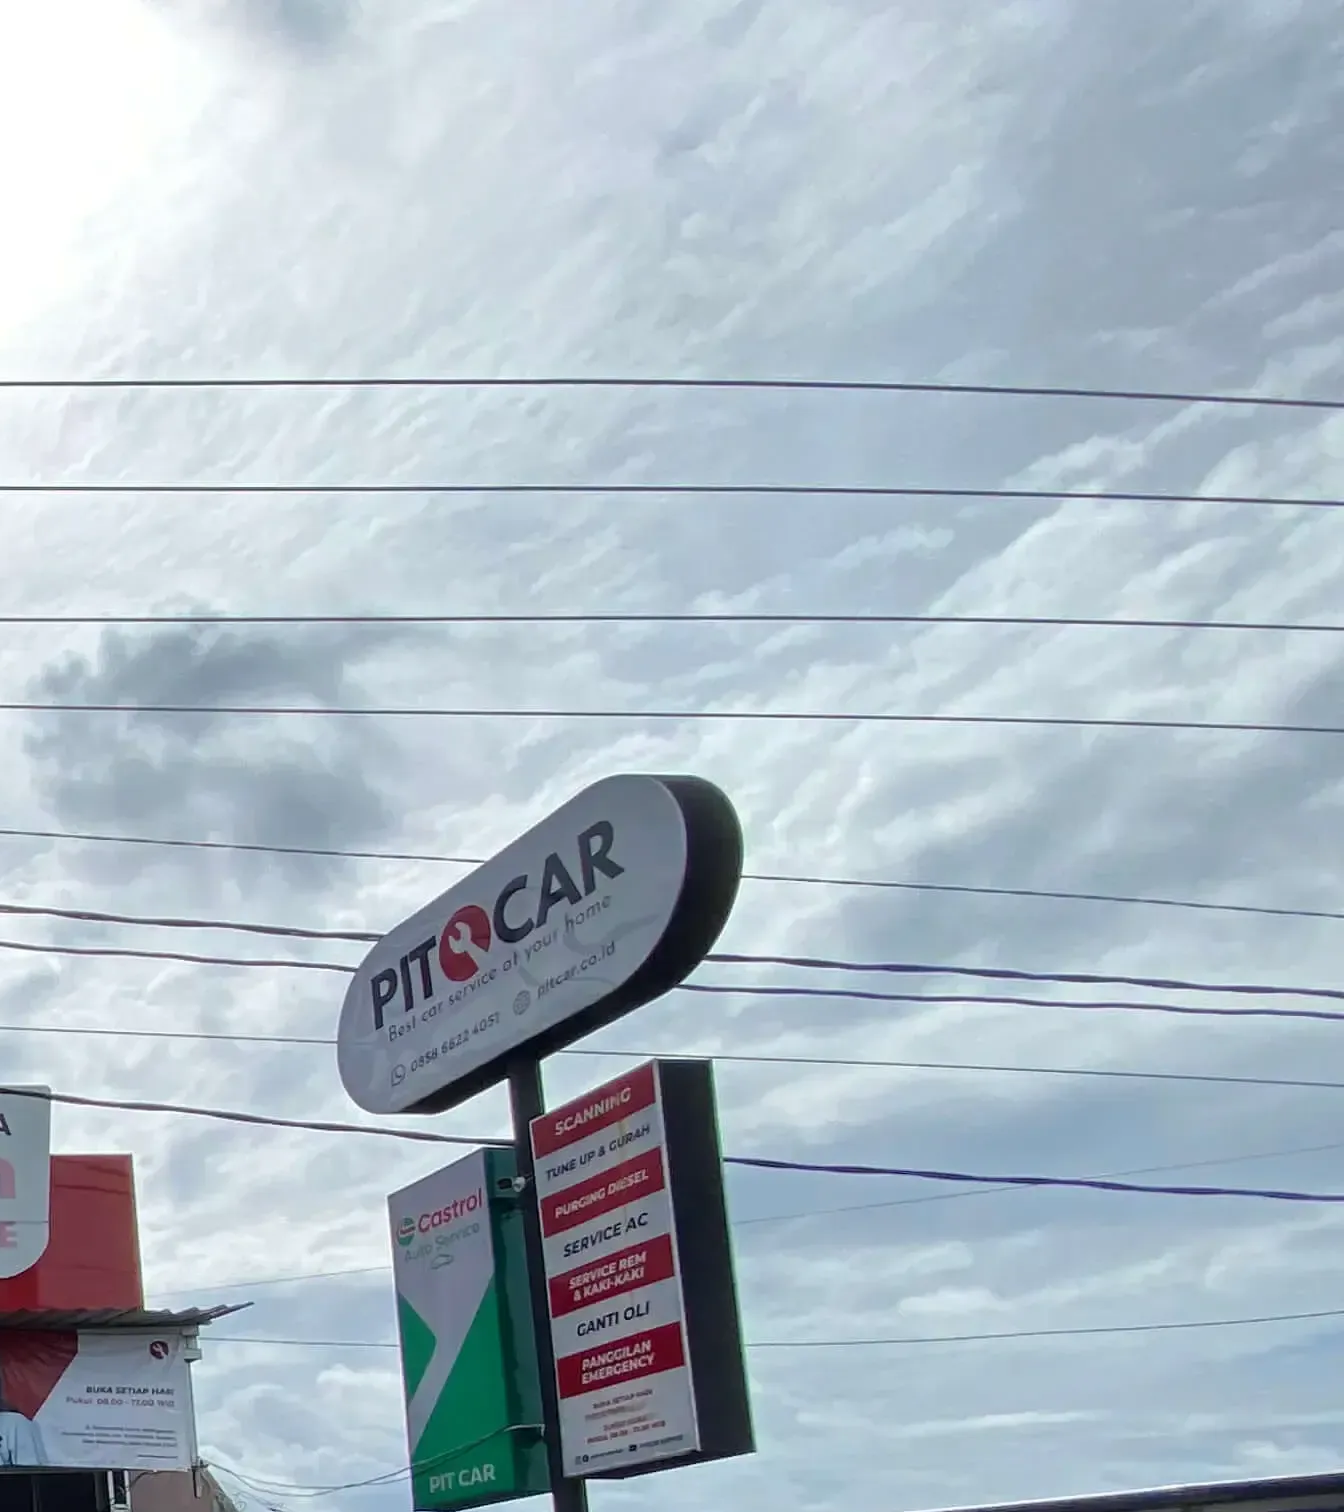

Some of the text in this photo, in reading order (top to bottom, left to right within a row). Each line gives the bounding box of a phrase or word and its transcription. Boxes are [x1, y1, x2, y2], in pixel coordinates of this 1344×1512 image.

[421, 1001, 444, 1023] car
[448, 968, 497, 1006] service
[522, 930, 560, 964] your
[564, 894, 612, 934] home
[555, 1087, 632, 1137] SCANNING
[545, 1124, 651, 1182] TUNE UP & GURAH
[417, 1186, 483, 1234] Castrol
[555, 1167, 649, 1220] PURGING DIESEL
[563, 1212, 649, 1258] SERVICE AC
[568, 1250, 647, 1290] SERVICE REM
[573, 1266, 645, 1301] & KAKI-KAKI
[576, 1301, 650, 1337] GANTI OLI
[581, 1353, 656, 1385] EMERGENCY
[582, 1339, 652, 1371] PANGGILAN
[86, 1385, 113, 1394] BUKA
[115, 1386, 149, 1395] SETIAP
[428, 1463, 496, 1494] PIT CAR
